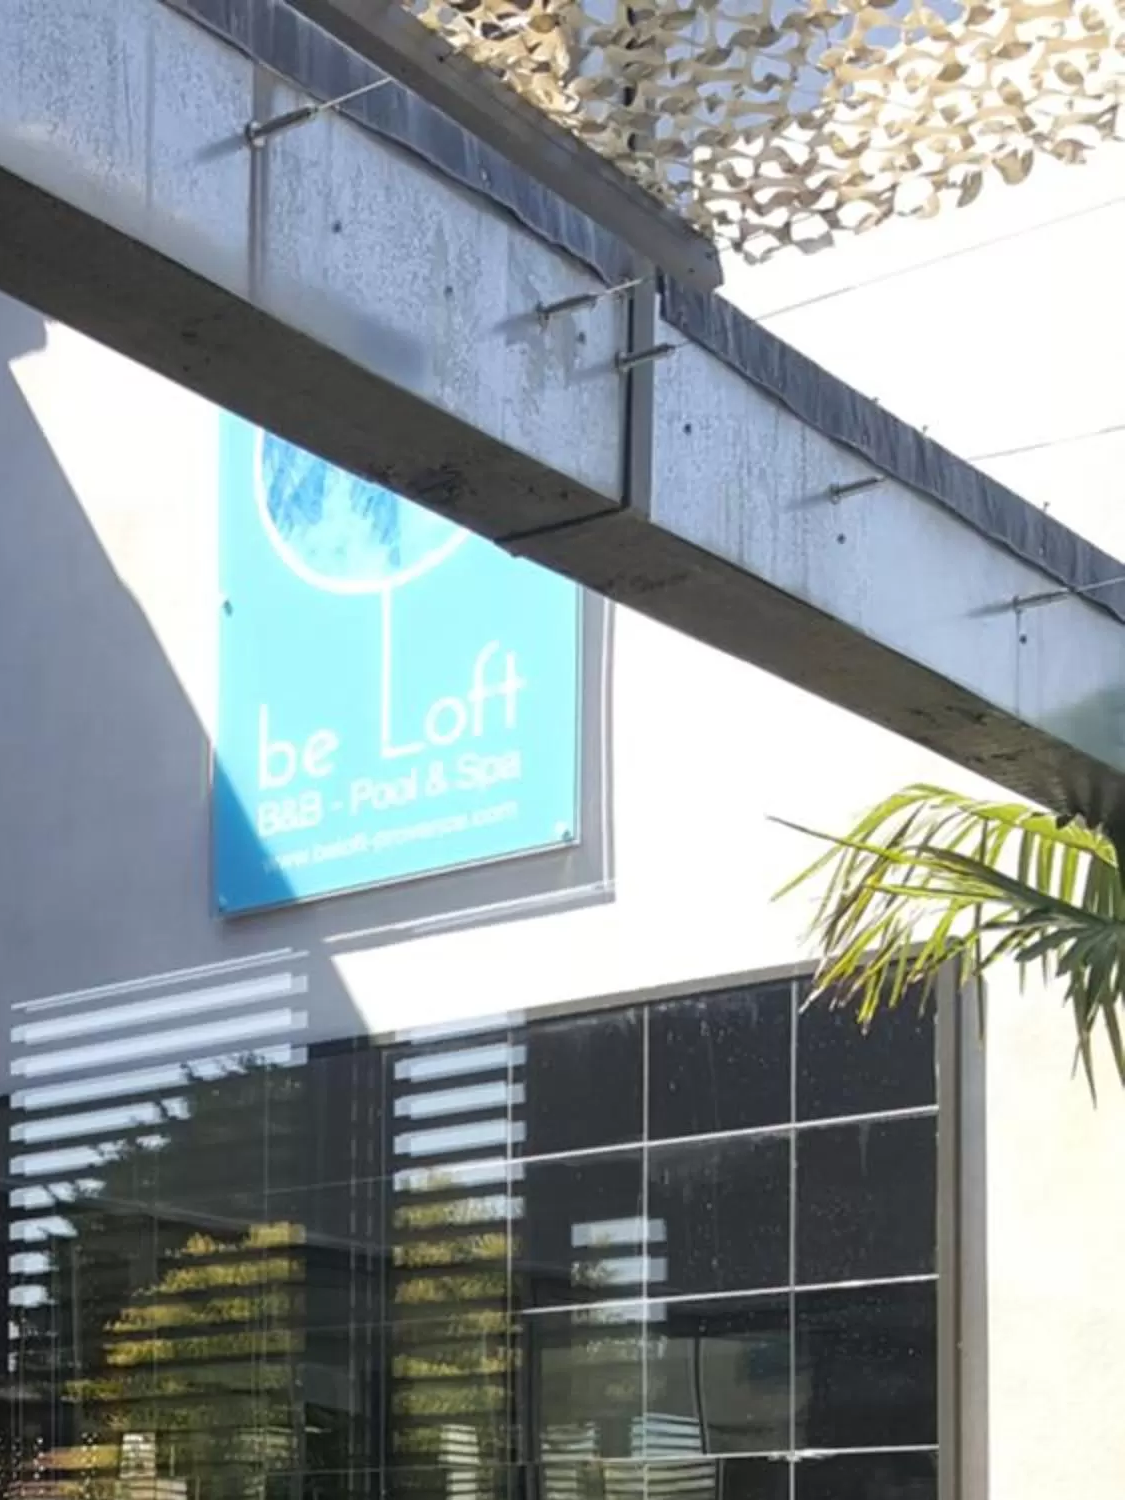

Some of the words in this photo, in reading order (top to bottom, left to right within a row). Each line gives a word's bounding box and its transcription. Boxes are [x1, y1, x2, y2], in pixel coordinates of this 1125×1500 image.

[258, 703, 339, 790] be
[380, 586, 526, 758] Loft
[349, 768, 418, 815] Pool
[425, 760, 448, 796] &
[457, 750, 521, 792] Spa
